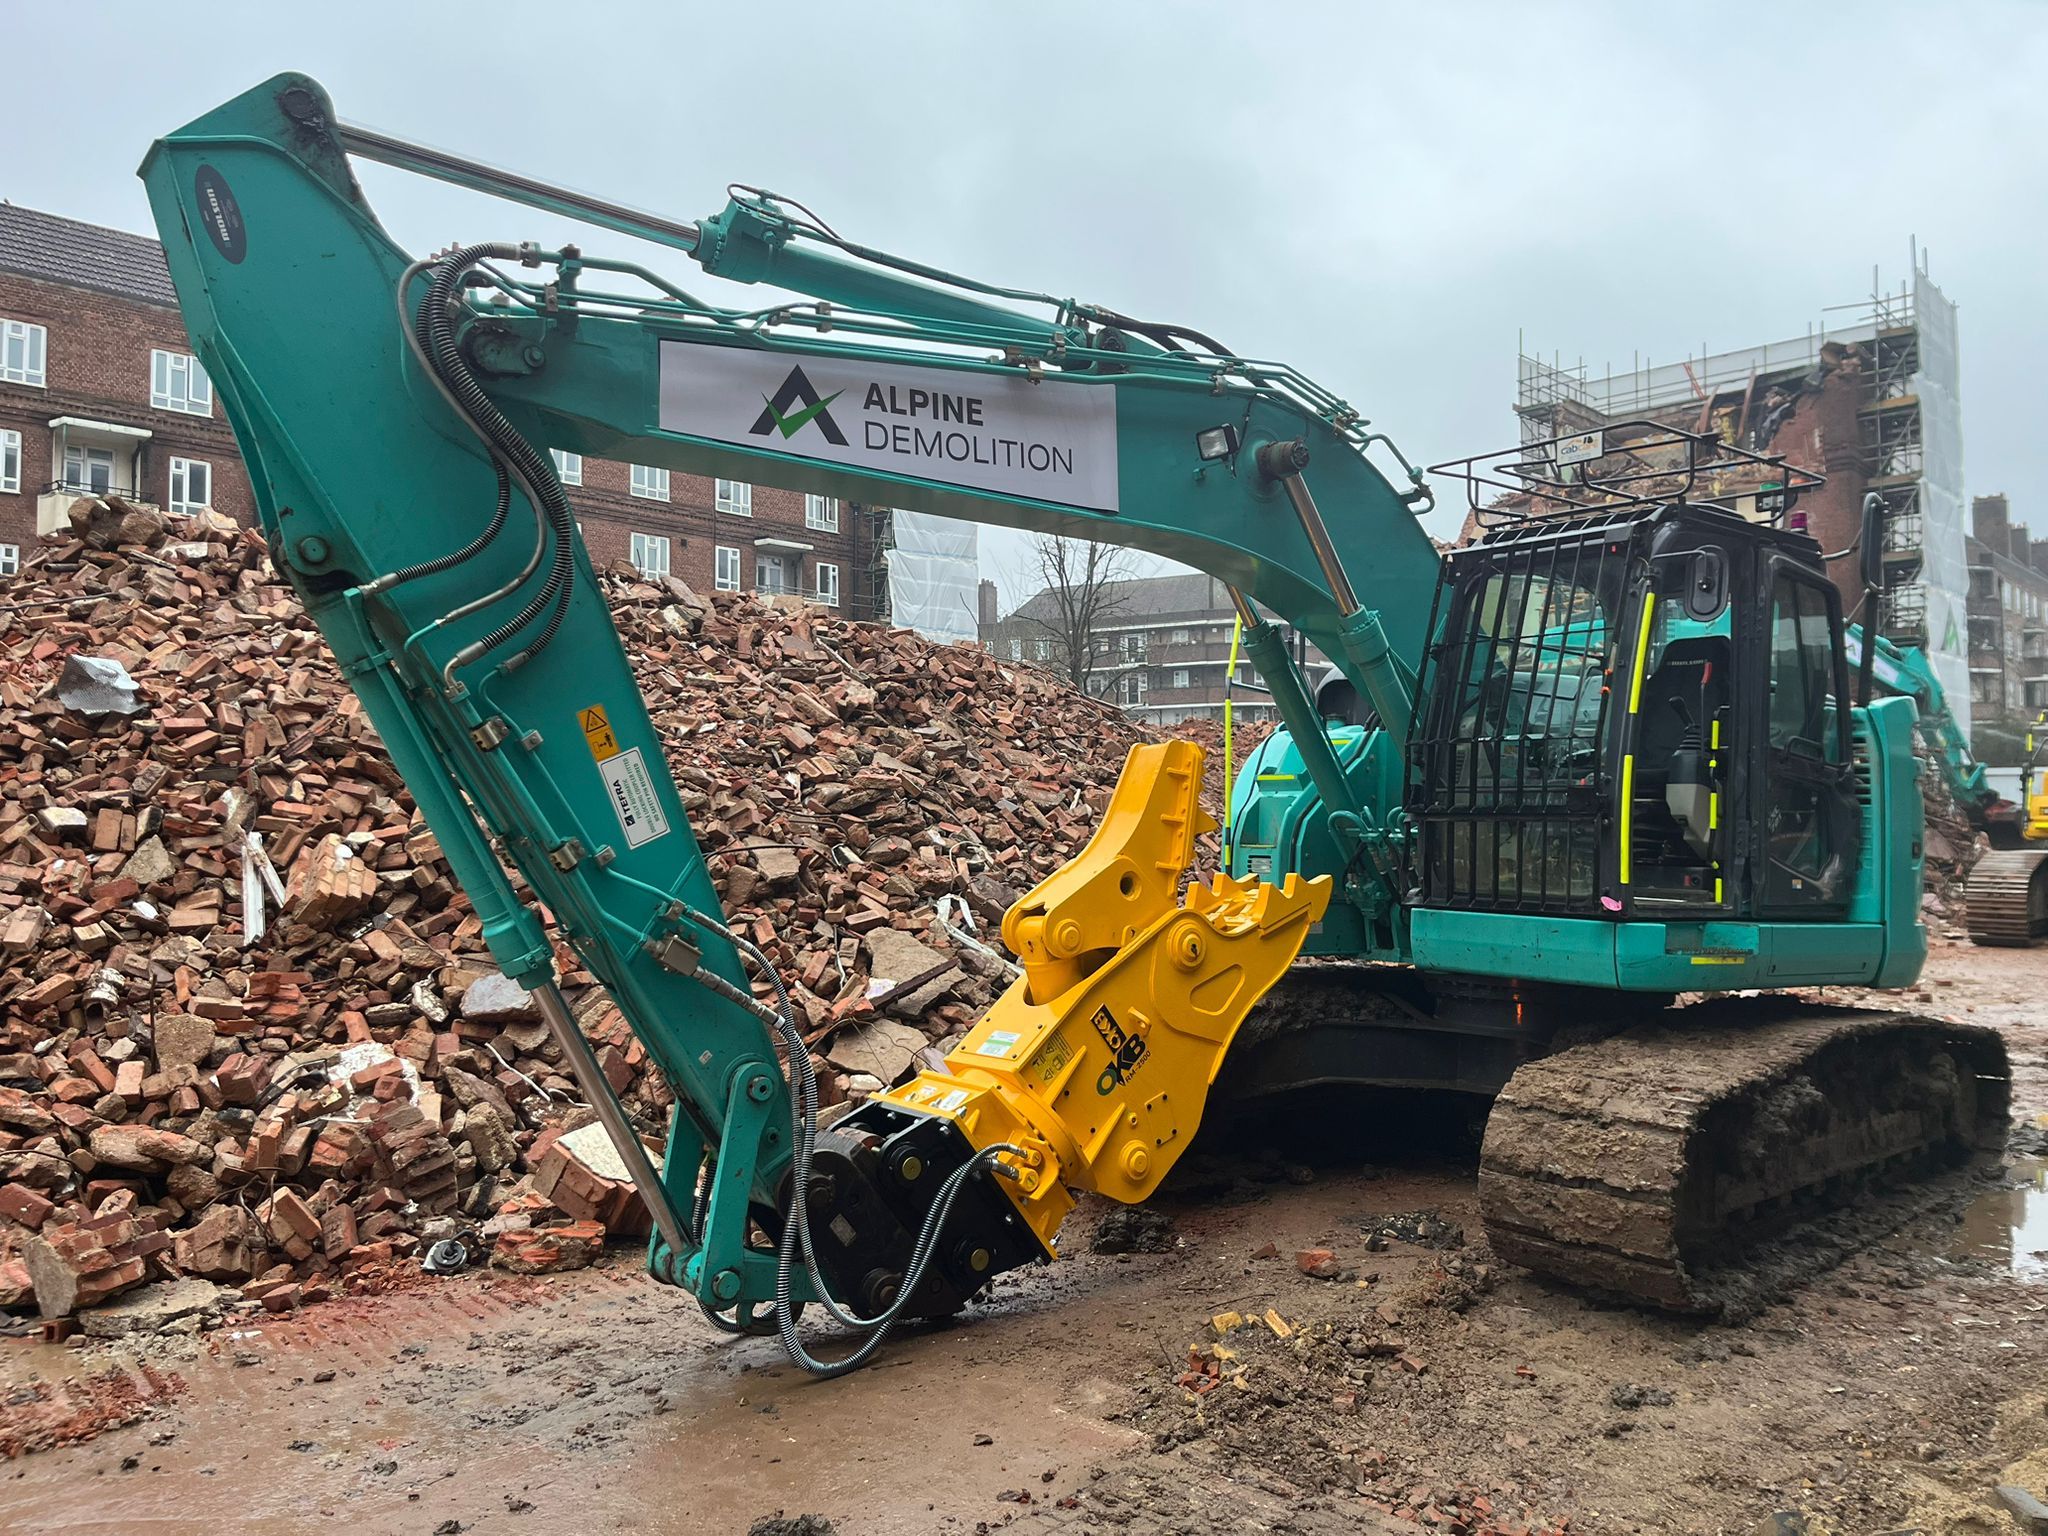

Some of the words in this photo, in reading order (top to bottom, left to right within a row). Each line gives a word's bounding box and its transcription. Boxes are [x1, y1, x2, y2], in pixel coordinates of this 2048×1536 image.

[864, 383, 984, 427] ALPINE
[865, 421, 1073, 474] DEMOLITION
[623, 758, 633, 774] FITTED
[633, 762, 646, 787] REQUIRED
[622, 779, 636, 805] AUTOMATIC
[629, 774, 641, 795] COUPLER
[612, 779, 631, 815] TEFRA
[637, 795, 649, 815] LOCKING
[646, 796, 657, 814] SAFETY
[633, 805, 642, 819] FULLY
[645, 814, 656, 833] DOUBLE
[653, 814, 660, 822] NO
[1097, 1034, 1147, 1096] OKB
[1125, 1051, 1151, 1083] RM-2500
